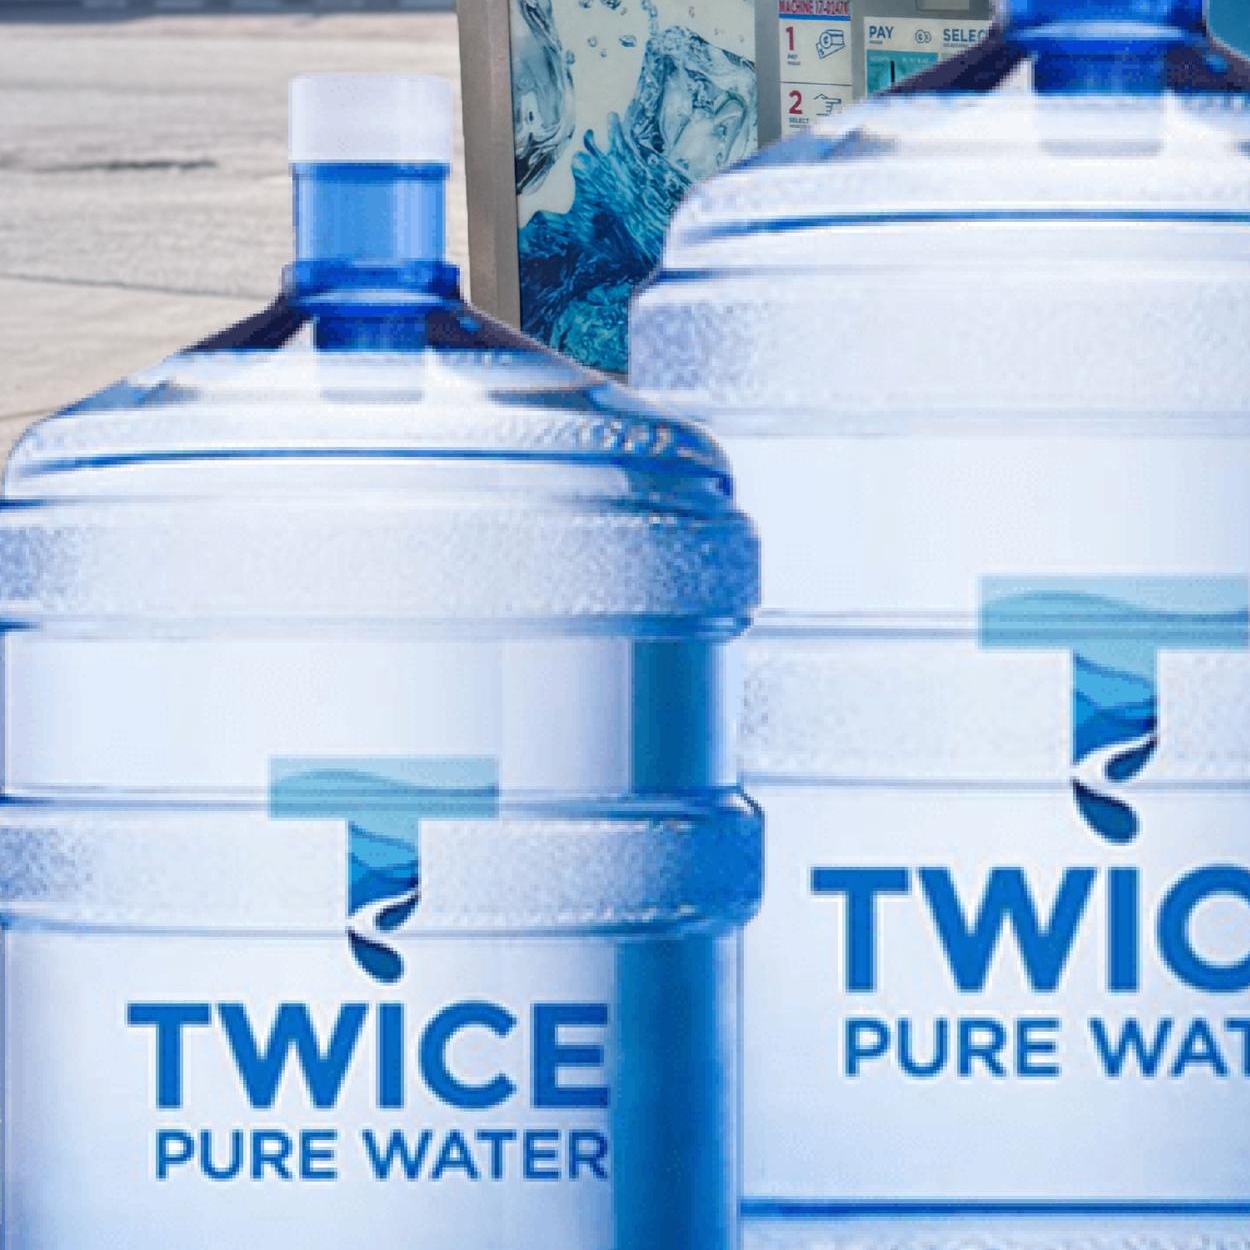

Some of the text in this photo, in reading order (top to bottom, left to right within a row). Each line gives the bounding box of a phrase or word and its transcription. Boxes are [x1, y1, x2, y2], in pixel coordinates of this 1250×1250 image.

[786, 27, 794, 51] 1
[869, 26, 893, 38] PAY
[943, 29, 986, 42] SELEC
[789, 90, 802, 114] 2
[127, 1002, 609, 1109] TWICE
[845, 1019, 1060, 1077] PURE
[156, 1129, 609, 1181] PURE WATER
